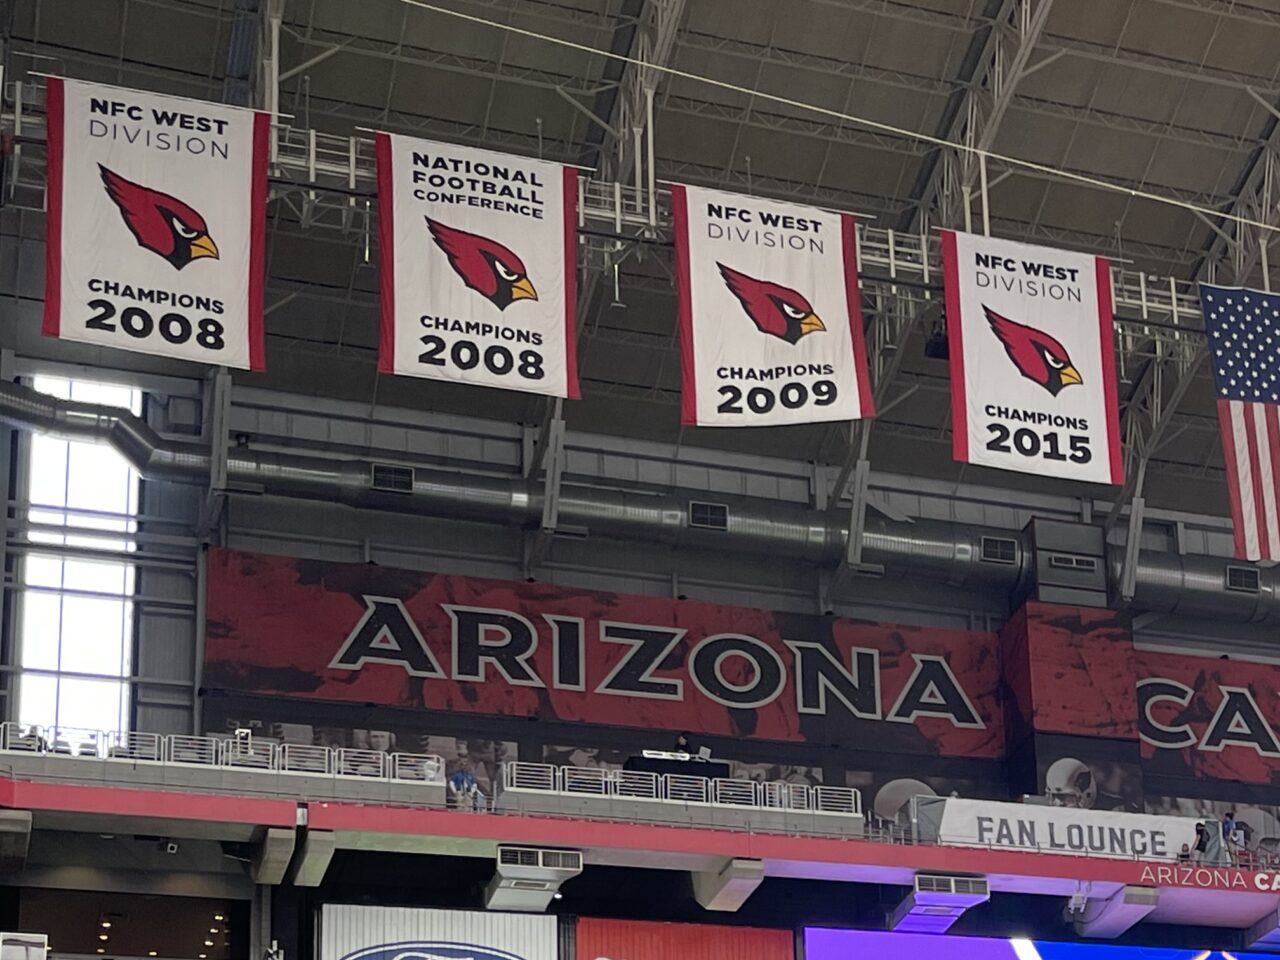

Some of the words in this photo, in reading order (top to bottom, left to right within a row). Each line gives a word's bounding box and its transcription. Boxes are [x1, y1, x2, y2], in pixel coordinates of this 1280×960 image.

[90, 97, 143, 122] NFC
[151, 109, 228, 136] WEST
[88, 119, 229, 160] DIVISION
[412, 152, 543, 187] NATIONAL
[412, 171, 544, 205] FOOTBALL
[413, 189, 544, 219] CONFERENCE
[706, 203, 752, 224] NFC
[759, 212, 822, 234] WEST
[707, 223, 825, 254] DIVISION
[974, 252, 1016, 273] NFC
[1021, 261, 1079, 283] WEST
[88, 278, 224, 314] CHAMPIONS
[975, 270, 1082, 302] DIVISION
[85, 298, 225, 350] 2008
[419, 315, 543, 346] CHAMPIONS
[418, 334, 545, 380] 2008
[716, 363, 834, 380] CHAMPIONS
[716, 380, 838, 414] 2009
[985, 404, 1089, 431] CHAMPIONS
[985, 424, 1092, 465] 2015
[328, 595, 989, 731] ARIZONA
[976, 816, 1037, 848] FAN
[1048, 821, 1169, 857] LOUNGE
[1140, 865, 1246, 890] ARIZONA
